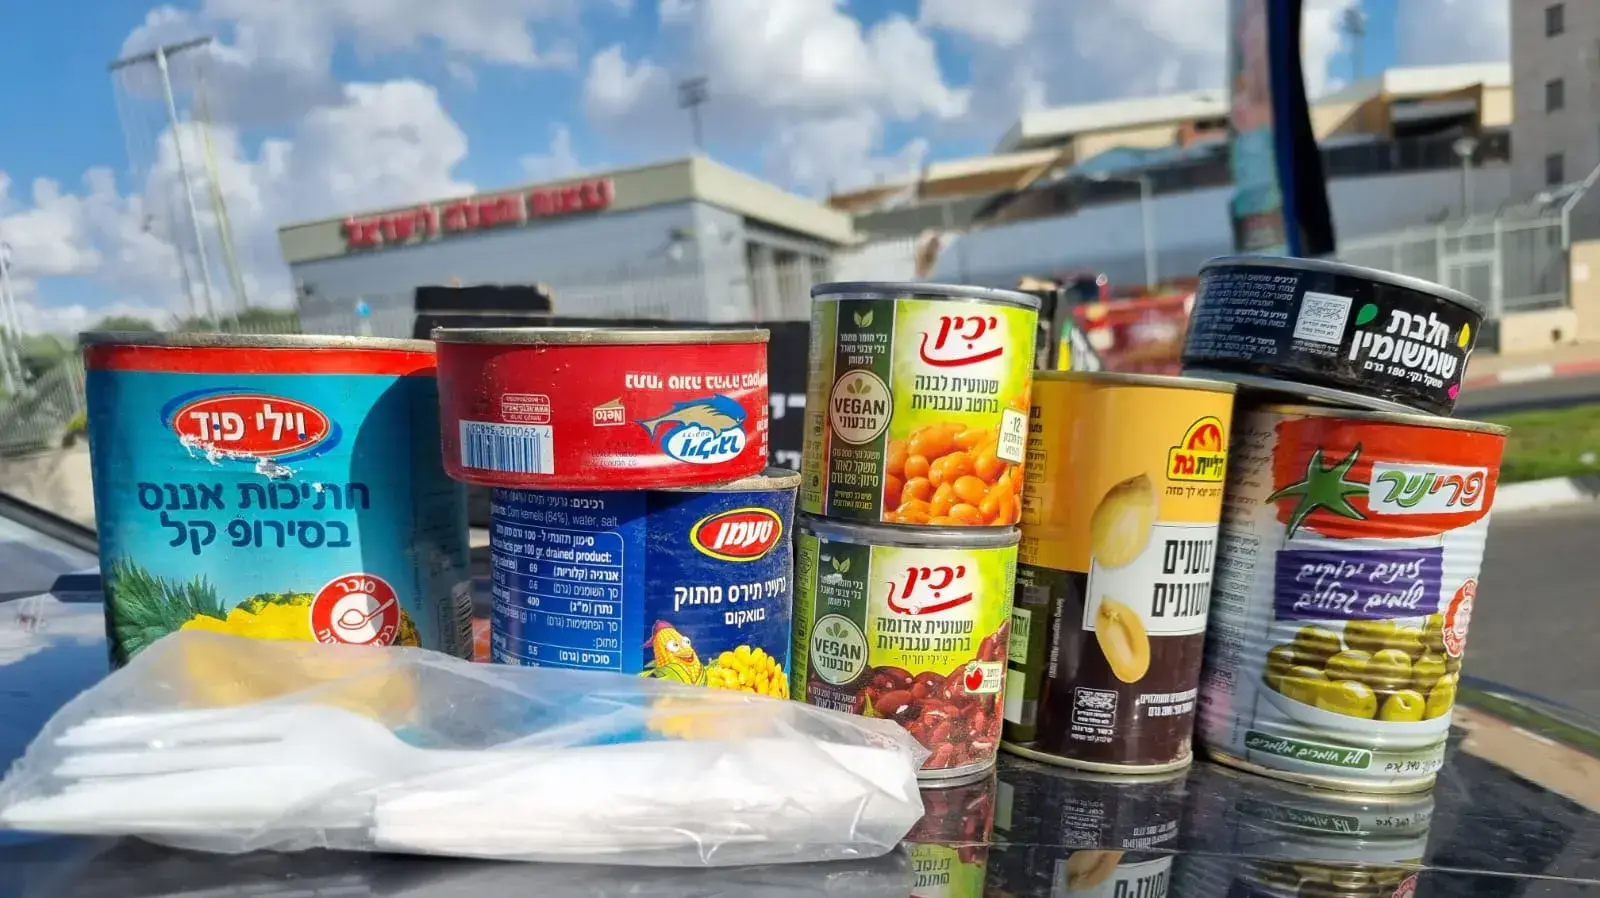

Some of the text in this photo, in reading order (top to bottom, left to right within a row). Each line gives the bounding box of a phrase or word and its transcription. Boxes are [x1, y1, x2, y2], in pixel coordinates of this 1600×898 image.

[934, 315, 998, 350] יכין
[1386, 308, 1450, 349] חלבת
[1348, 330, 1458, 379] שומשומין
[1364, 360, 1385, 373] גרם
[1387, 365, 1405, 377] 180
[626, 374, 662, 390] נתחי
[668, 374, 702, 391] טונה
[706, 374, 740, 390] בהירה
[914, 374, 999, 394] שעועית לבנה
[1421, 375, 1443, 388] משקל
[834, 397, 885, 415] VEGAN
[912, 394, 998, 413] ברוטב עגבניות
[190, 404, 306, 441] וילי פוד
[595, 410, 623, 423] Neto
[839, 415, 876, 430] טבעוני
[680, 436, 741, 460] ויליגר
[1173, 453, 1194, 475] גת
[845, 473, 857, 485] 128
[138, 482, 370, 510] חתיכות אננס
[1165, 486, 1183, 496] מזה
[570, 498, 605, 510] רכיבים:
[573, 514, 599, 528] water,
[160, 511, 351, 555] בסירופ קל
[524, 529, 536, 541] 100
[573, 535, 595, 547] סימון
[713, 520, 774, 549] טעמן
[546, 546, 574, 560] drained
[575, 551, 612, 564] product:
[1162, 539, 1213, 575] בוטנים
[553, 565, 619, 582] אנרגיה (קלוריות)
[902, 565, 966, 599] יכין
[1296, 557, 1426, 591] זיתים ירוקים
[336, 579, 376, 593] סוכר
[728, 582, 762, 602] תירס
[527, 596, 540, 607] 400
[674, 586, 723, 612] מתוק
[1293, 579, 1425, 613] שלמים גדולים
[725, 607, 765, 629] בוואקום
[877, 617, 973, 634] שעועית אדומה
[814, 637, 860, 660] VEGAN
[877, 634, 972, 652] ברוטב עגבניות
[581, 652, 610, 665] סוכרים
[818, 655, 853, 673] טבעוני
